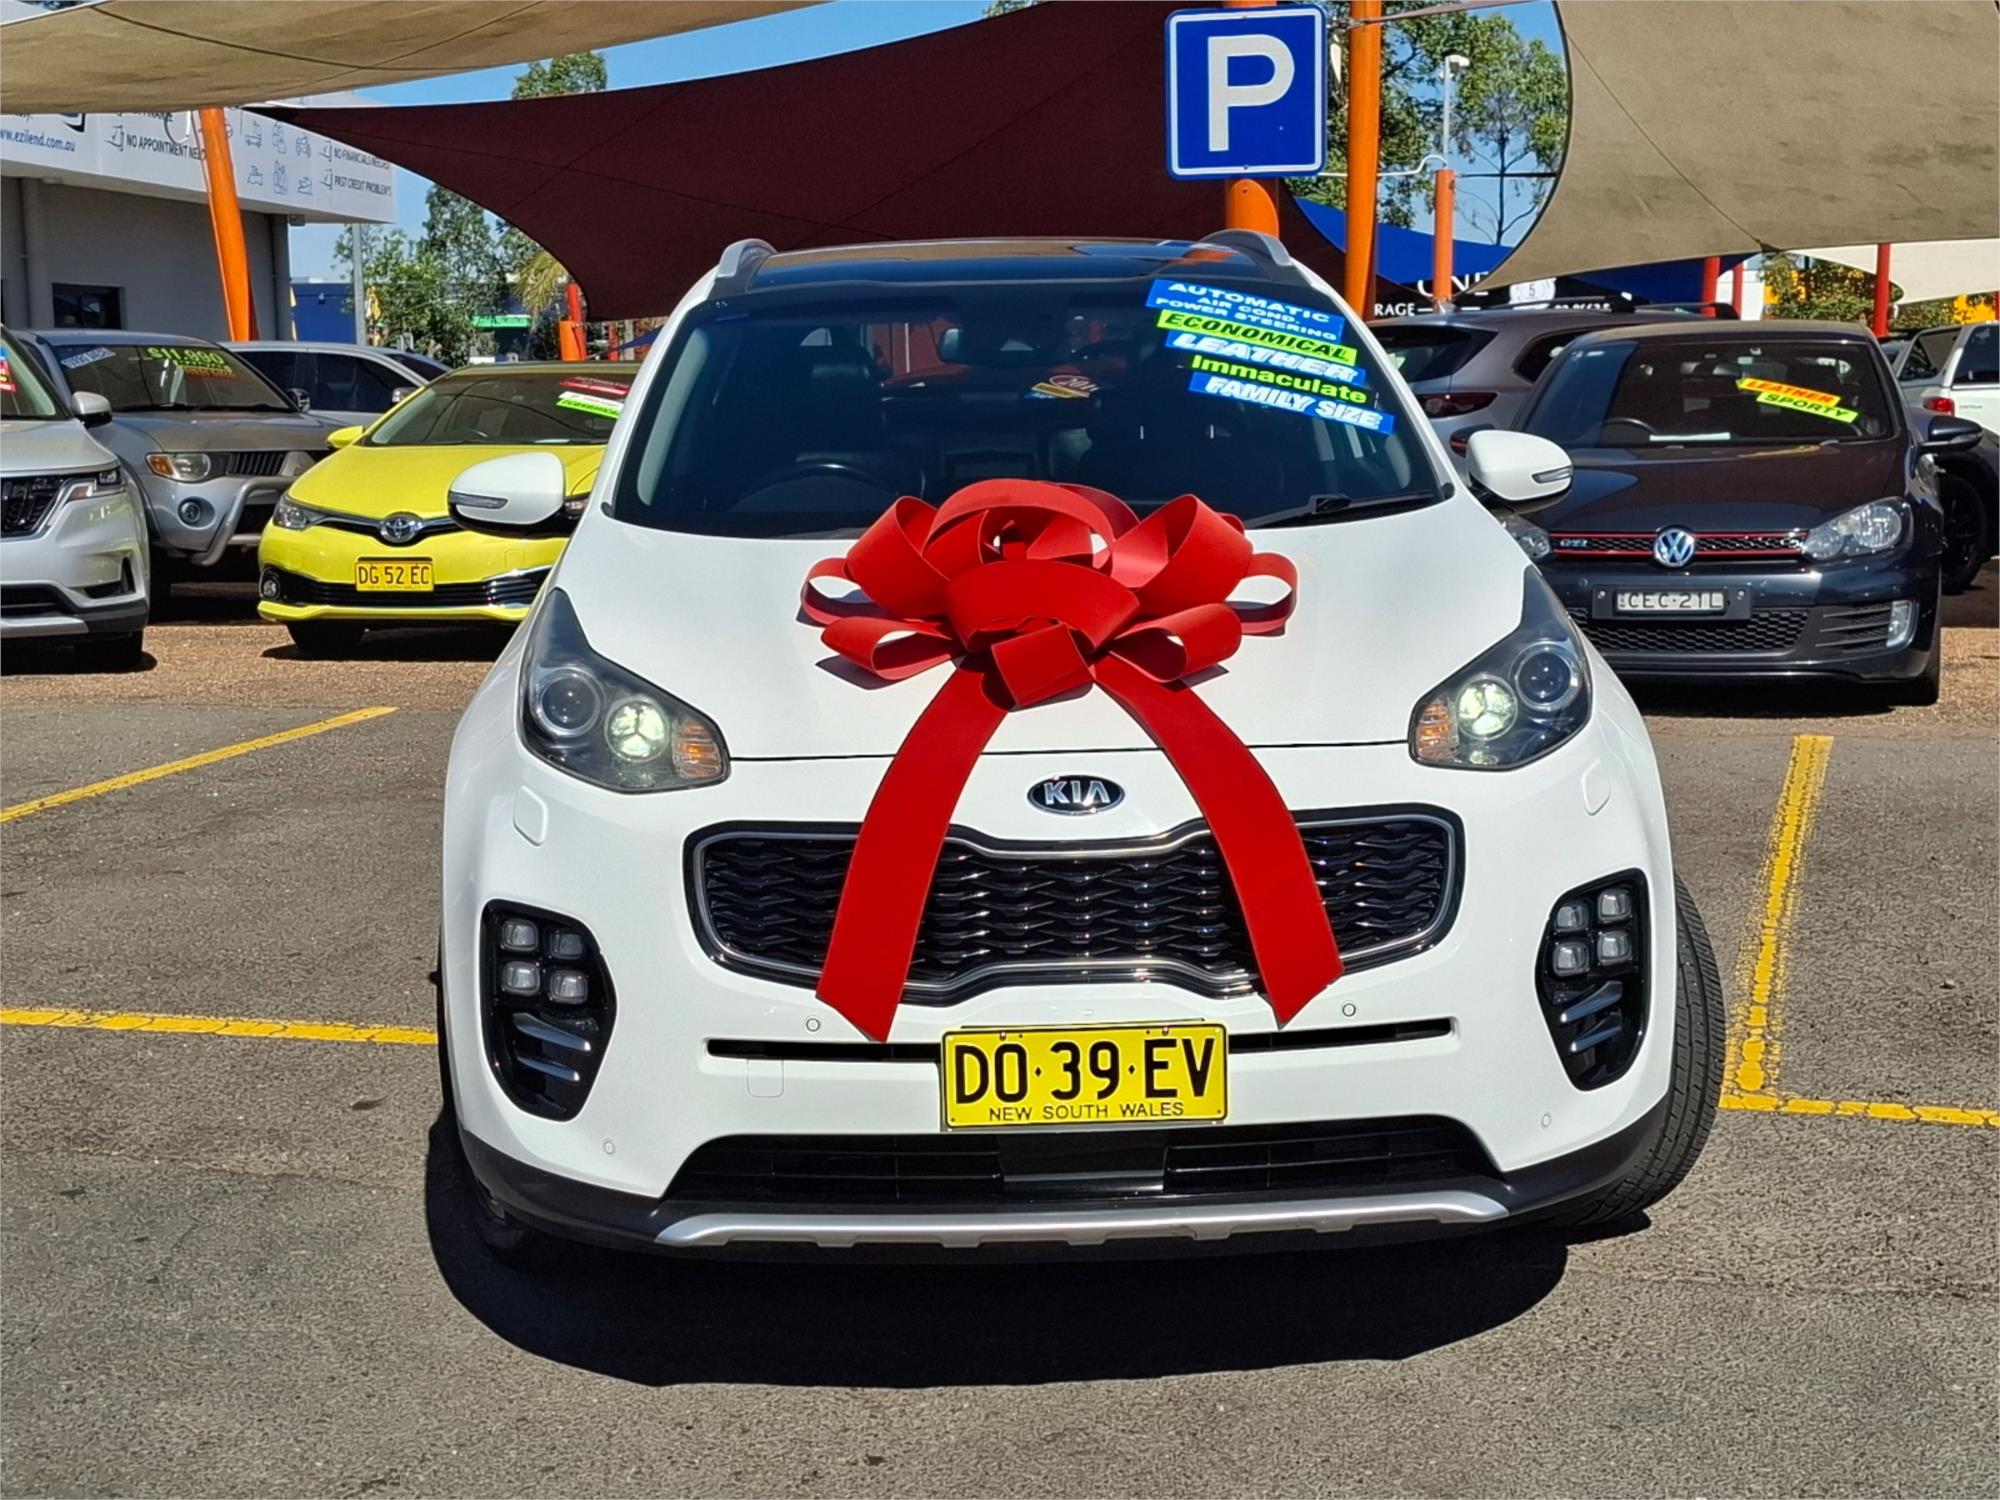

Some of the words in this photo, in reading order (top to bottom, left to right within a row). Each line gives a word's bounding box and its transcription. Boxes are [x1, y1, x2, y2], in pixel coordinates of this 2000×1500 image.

[1208, 34, 1295, 152] P
[126, 134, 137, 148] NO
[139, 137, 188, 158] APPOINTMENT
[1155, 297, 1229, 317] POWER
[1234, 313, 1337, 341] STEERING
[1168, 282, 1330, 324] AUTOMATIC
[1196, 296, 1231, 311] AIR
[1164, 312, 1350, 361] ECONOMICAL
[1172, 332, 1359, 382] LEATHER
[1190, 354, 1368, 405] Immaculate
[1746, 380, 1834, 403] LEATHER
[1204, 376, 1316, 413] FAMILY
[1315, 399, 1383, 431] SIZE
[1764, 393, 1850, 417] SPORTY
[1043, 780, 1111, 806] KIA
[989, 1106, 1033, 1122] NEW
[1042, 1103, 1109, 1120] SOUTH
[1119, 1101, 1185, 1118] WALES
